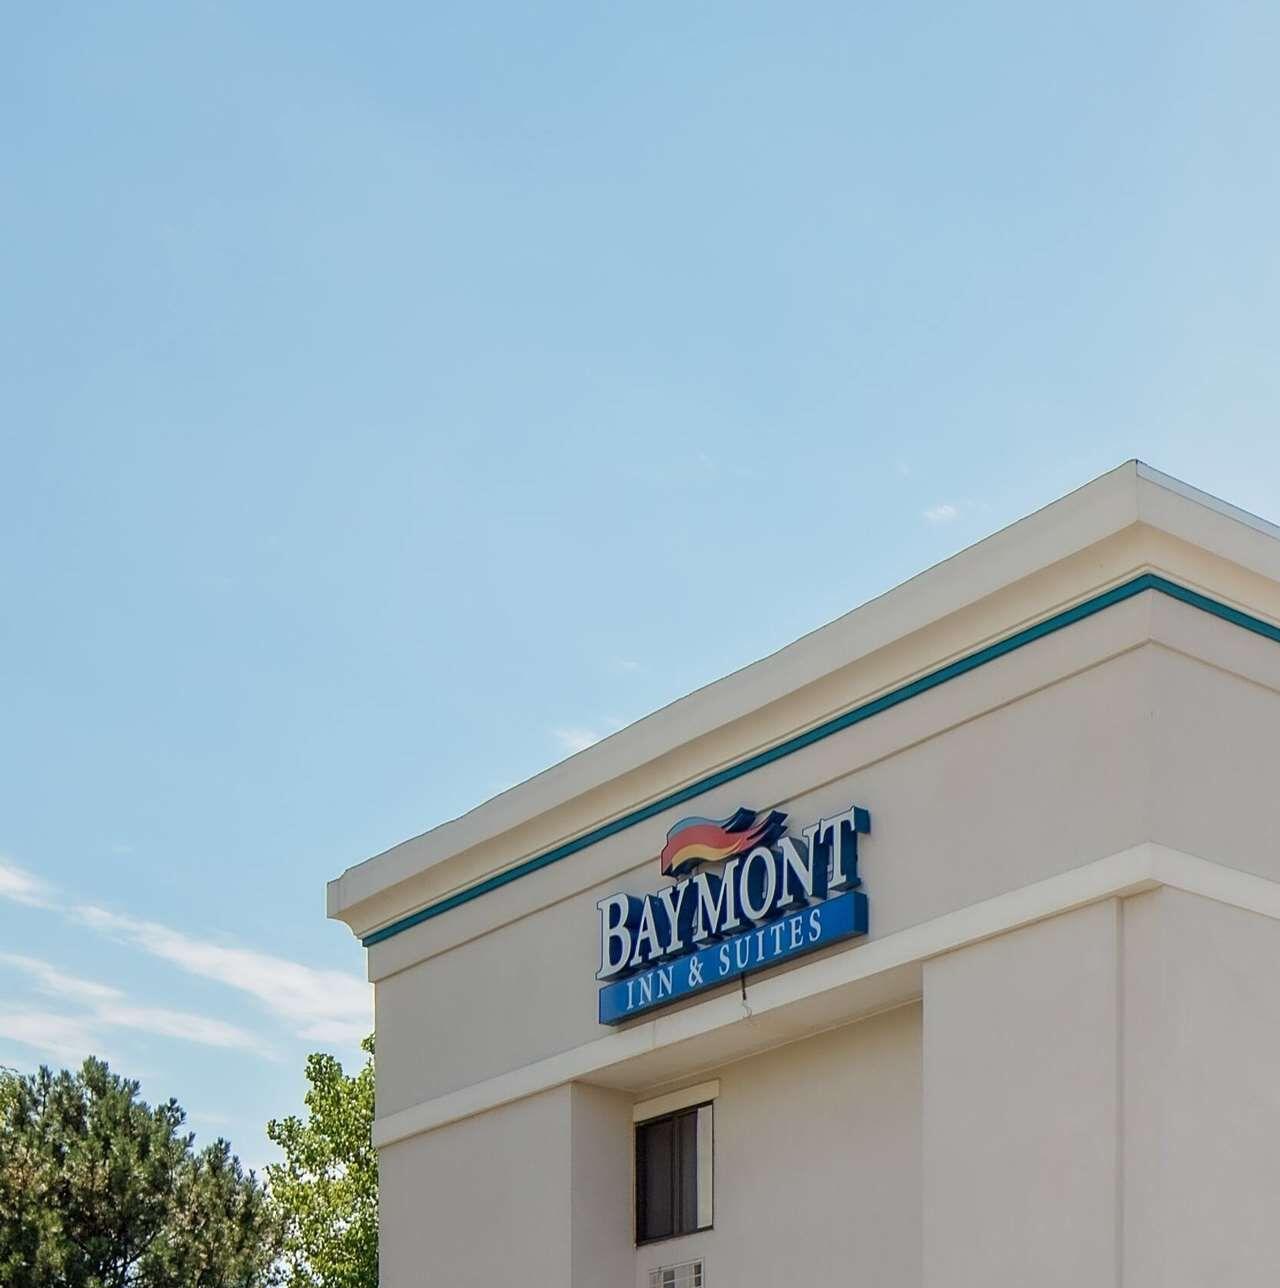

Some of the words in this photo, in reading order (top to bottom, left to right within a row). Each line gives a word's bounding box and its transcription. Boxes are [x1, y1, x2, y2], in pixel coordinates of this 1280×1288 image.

[595, 805, 859, 980] BAYMONT
[625, 964, 675, 1010] INN
[687, 956, 704, 988] &
[717, 908, 823, 976] SUITES
